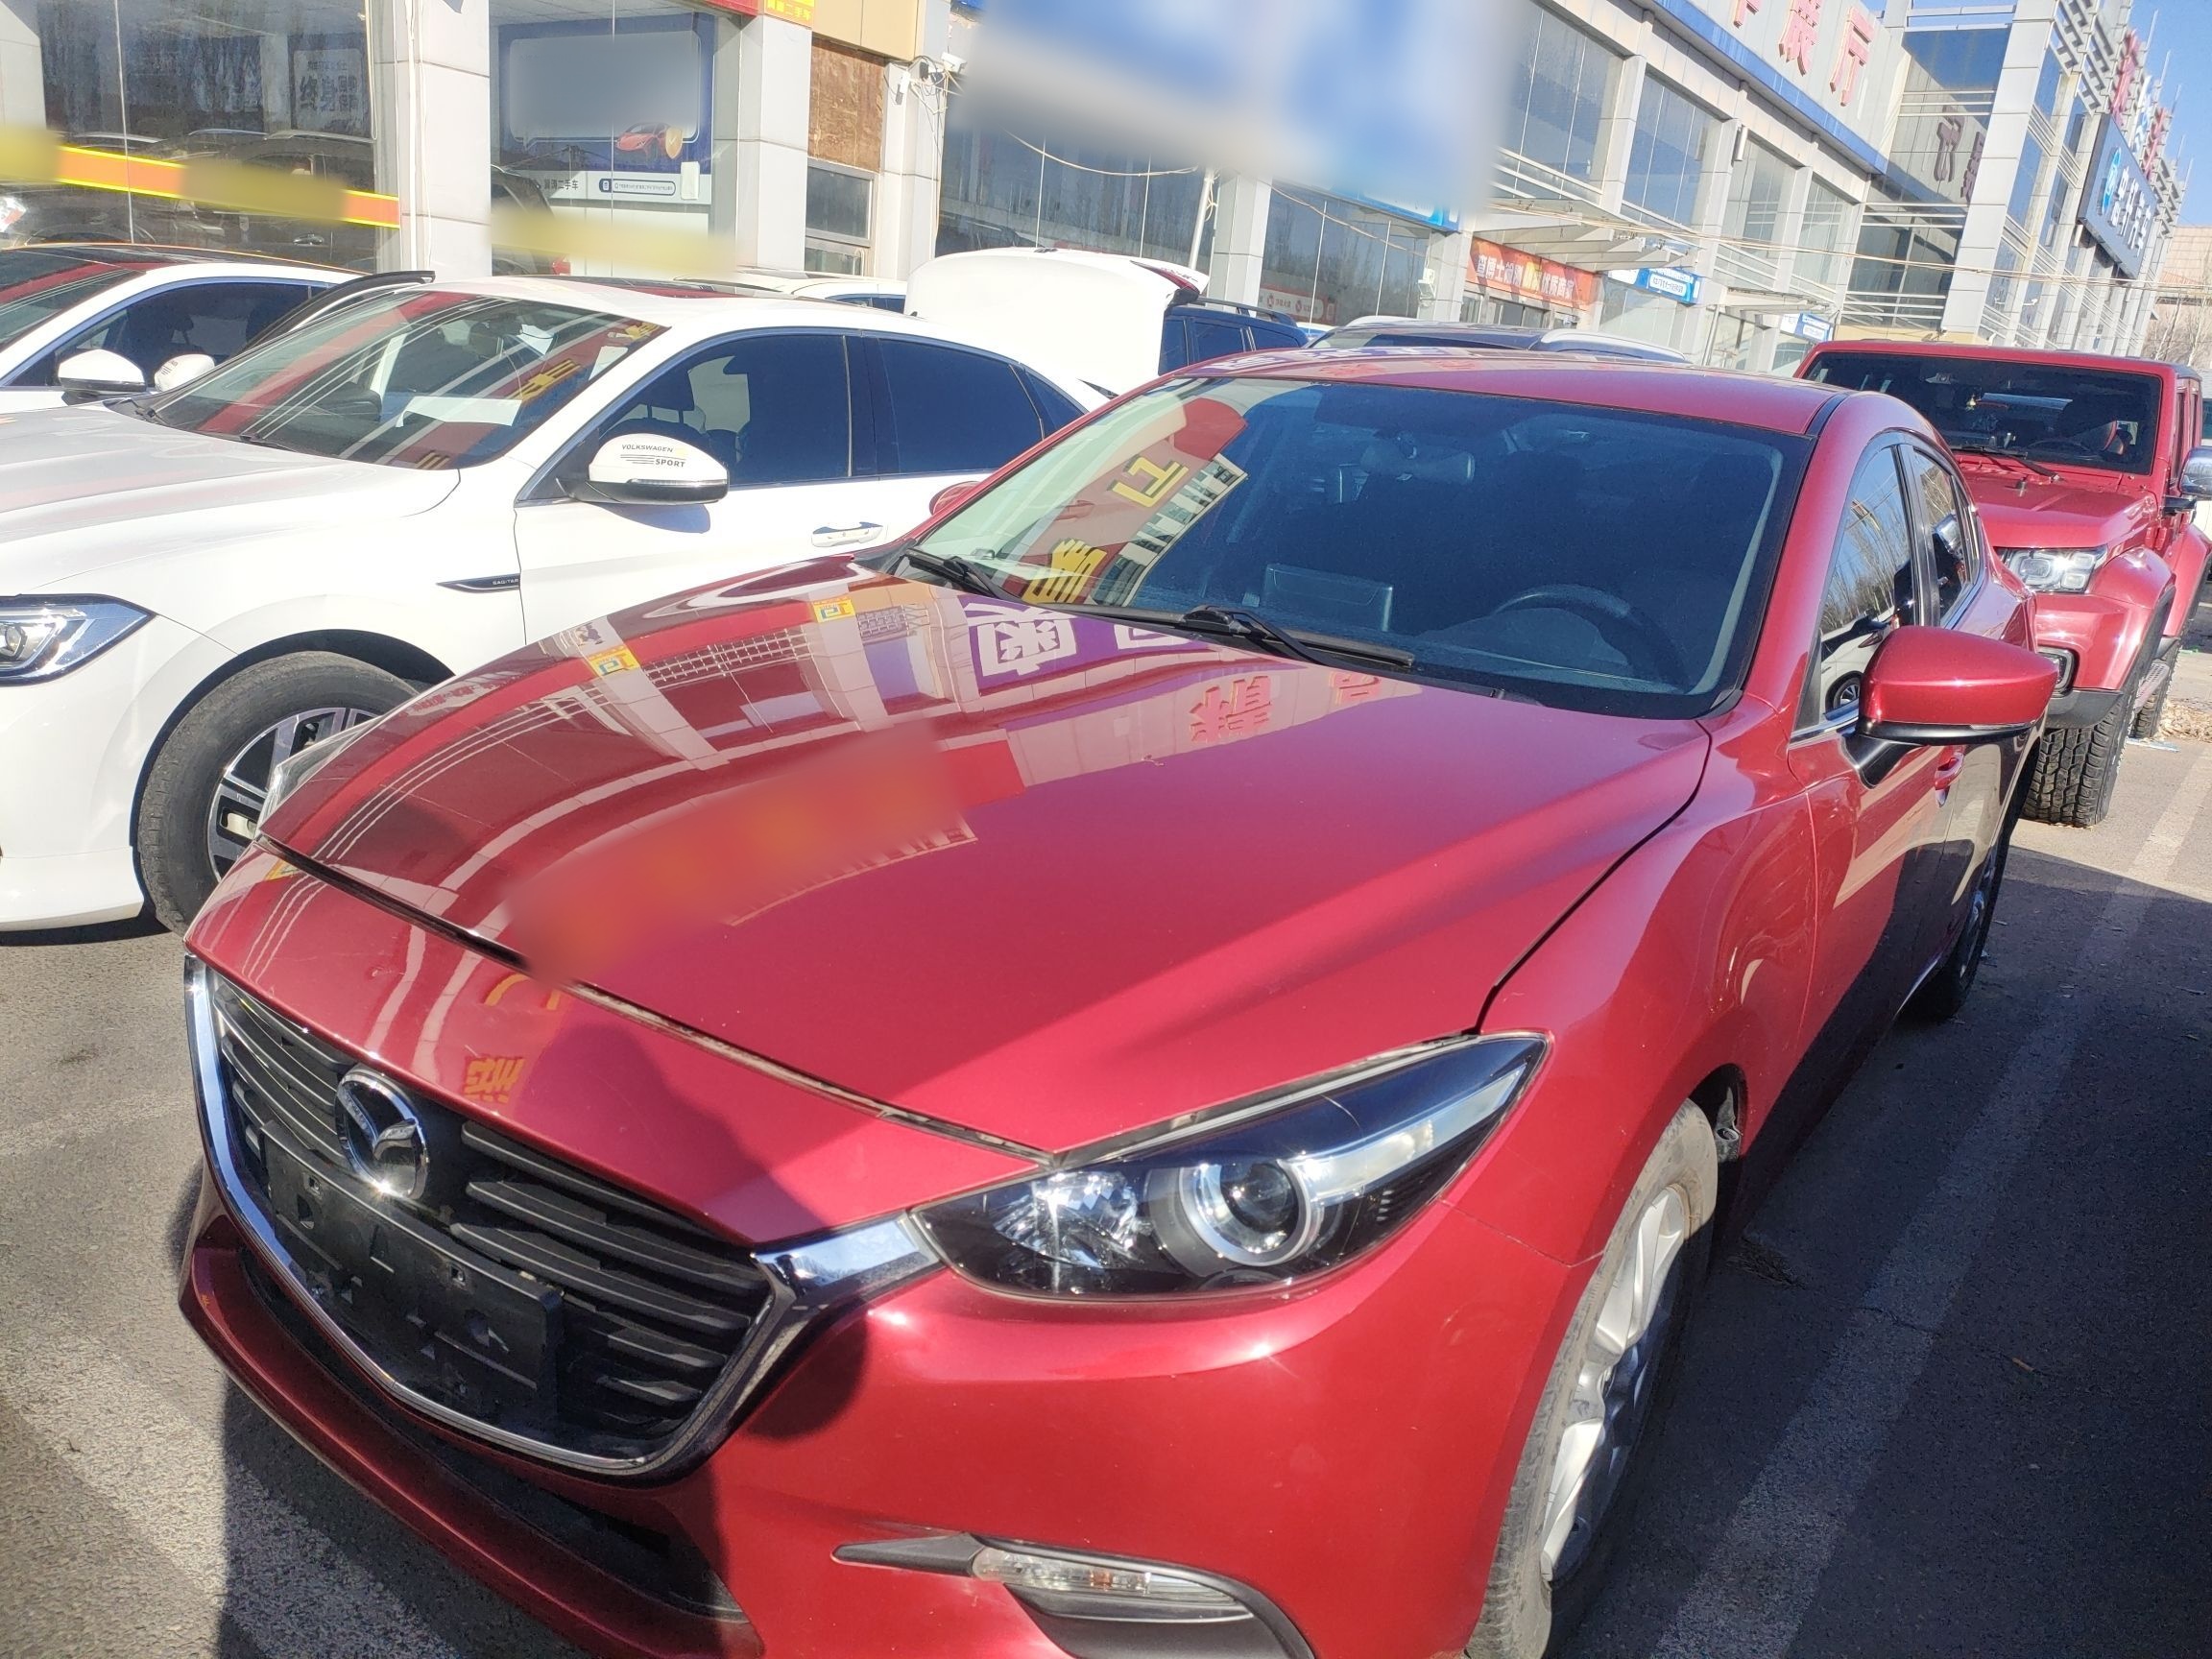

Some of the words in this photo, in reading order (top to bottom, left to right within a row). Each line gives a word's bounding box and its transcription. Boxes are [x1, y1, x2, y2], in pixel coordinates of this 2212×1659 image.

[1733, 0, 1875, 107] 展厅
[621, 444, 674, 453] VOLKSWAGEN
[655, 458, 685, 468] SPORT
